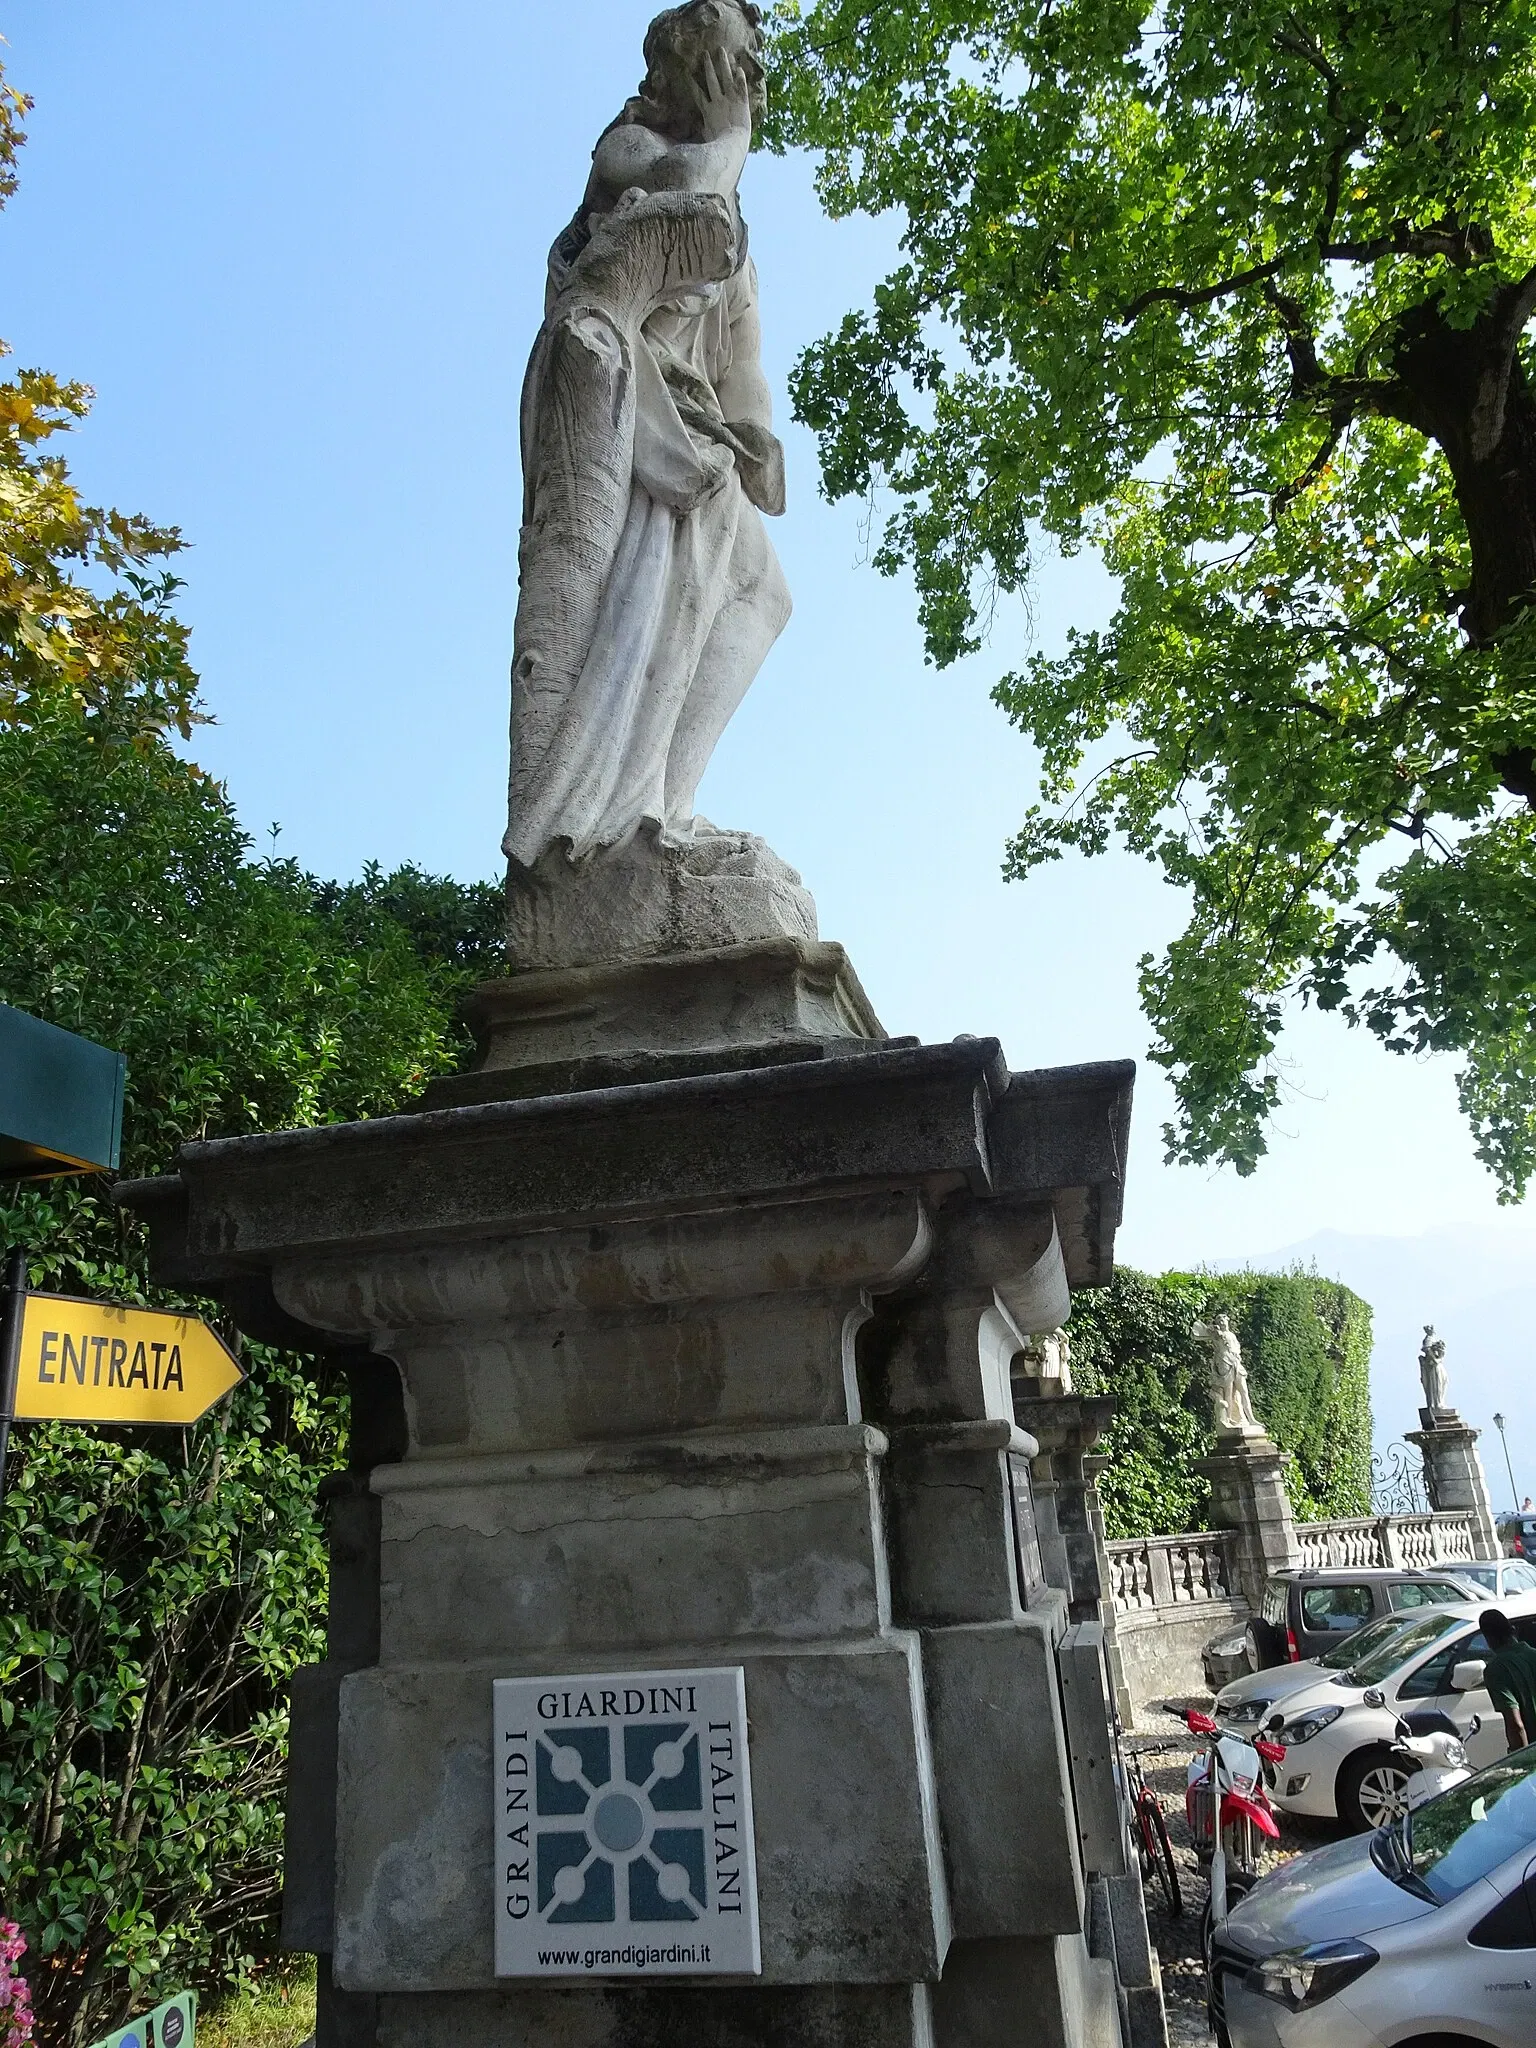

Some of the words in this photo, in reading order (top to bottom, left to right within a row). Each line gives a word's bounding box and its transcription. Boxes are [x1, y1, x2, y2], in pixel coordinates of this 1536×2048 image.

[38, 1330, 184, 1392] ENTRATA
[537, 1686, 698, 1719] GIARDINI
[505, 1729, 530, 1919] GRANDI
[708, 1720, 742, 1915] ITALIANI
[537, 1944, 711, 1968] www.grandigiardini.it
